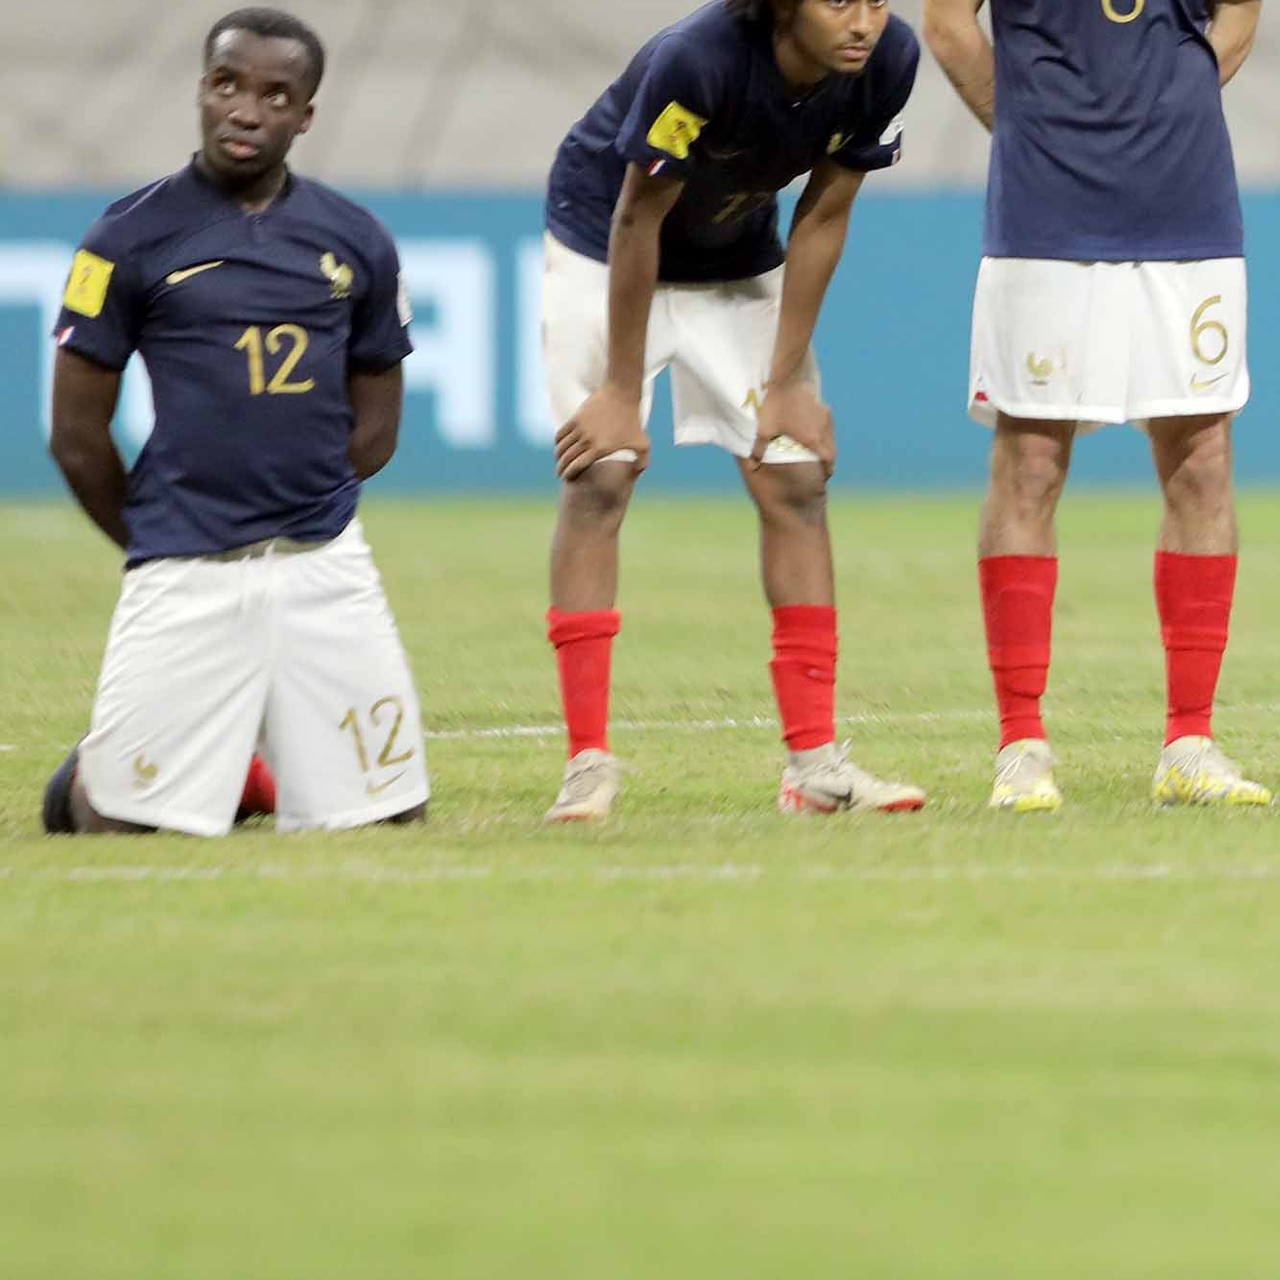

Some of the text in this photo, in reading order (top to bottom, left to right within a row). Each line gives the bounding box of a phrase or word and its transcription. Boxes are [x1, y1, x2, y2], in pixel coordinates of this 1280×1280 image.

[234, 323, 315, 395] 12
[1190, 294, 1229, 366] 6
[340, 696, 415, 772] 12
